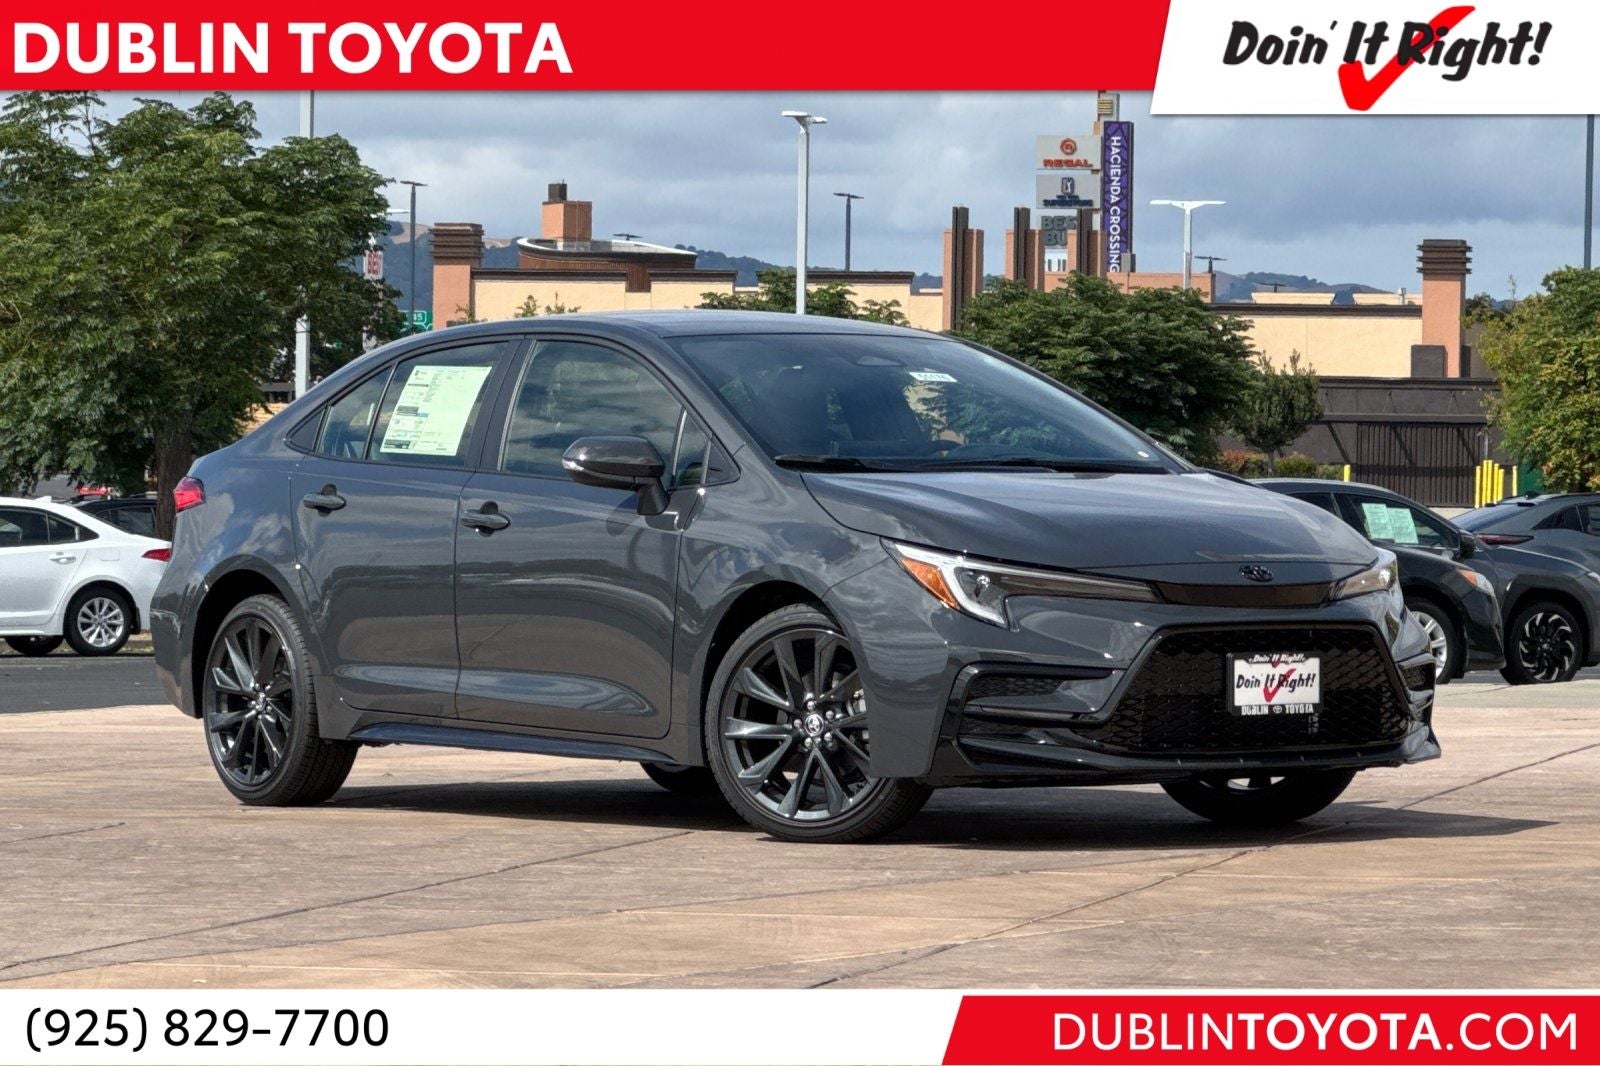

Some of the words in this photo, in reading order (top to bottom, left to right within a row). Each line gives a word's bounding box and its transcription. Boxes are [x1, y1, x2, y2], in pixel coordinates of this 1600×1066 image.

[1043, 159, 1093, 168] REGAL
[1110, 136, 1121, 204] HACIENDA
[1043, 231, 1068, 246] BU
[1109, 206, 1121, 273] CROSSING
[1236, 673, 1264, 689] Doin'
[1265, 673, 1275, 688] It
[1278, 672, 1316, 693] Right!
[1241, 705, 1269, 715] DUBLIN
[1285, 704, 1314, 714] TOYOTA
